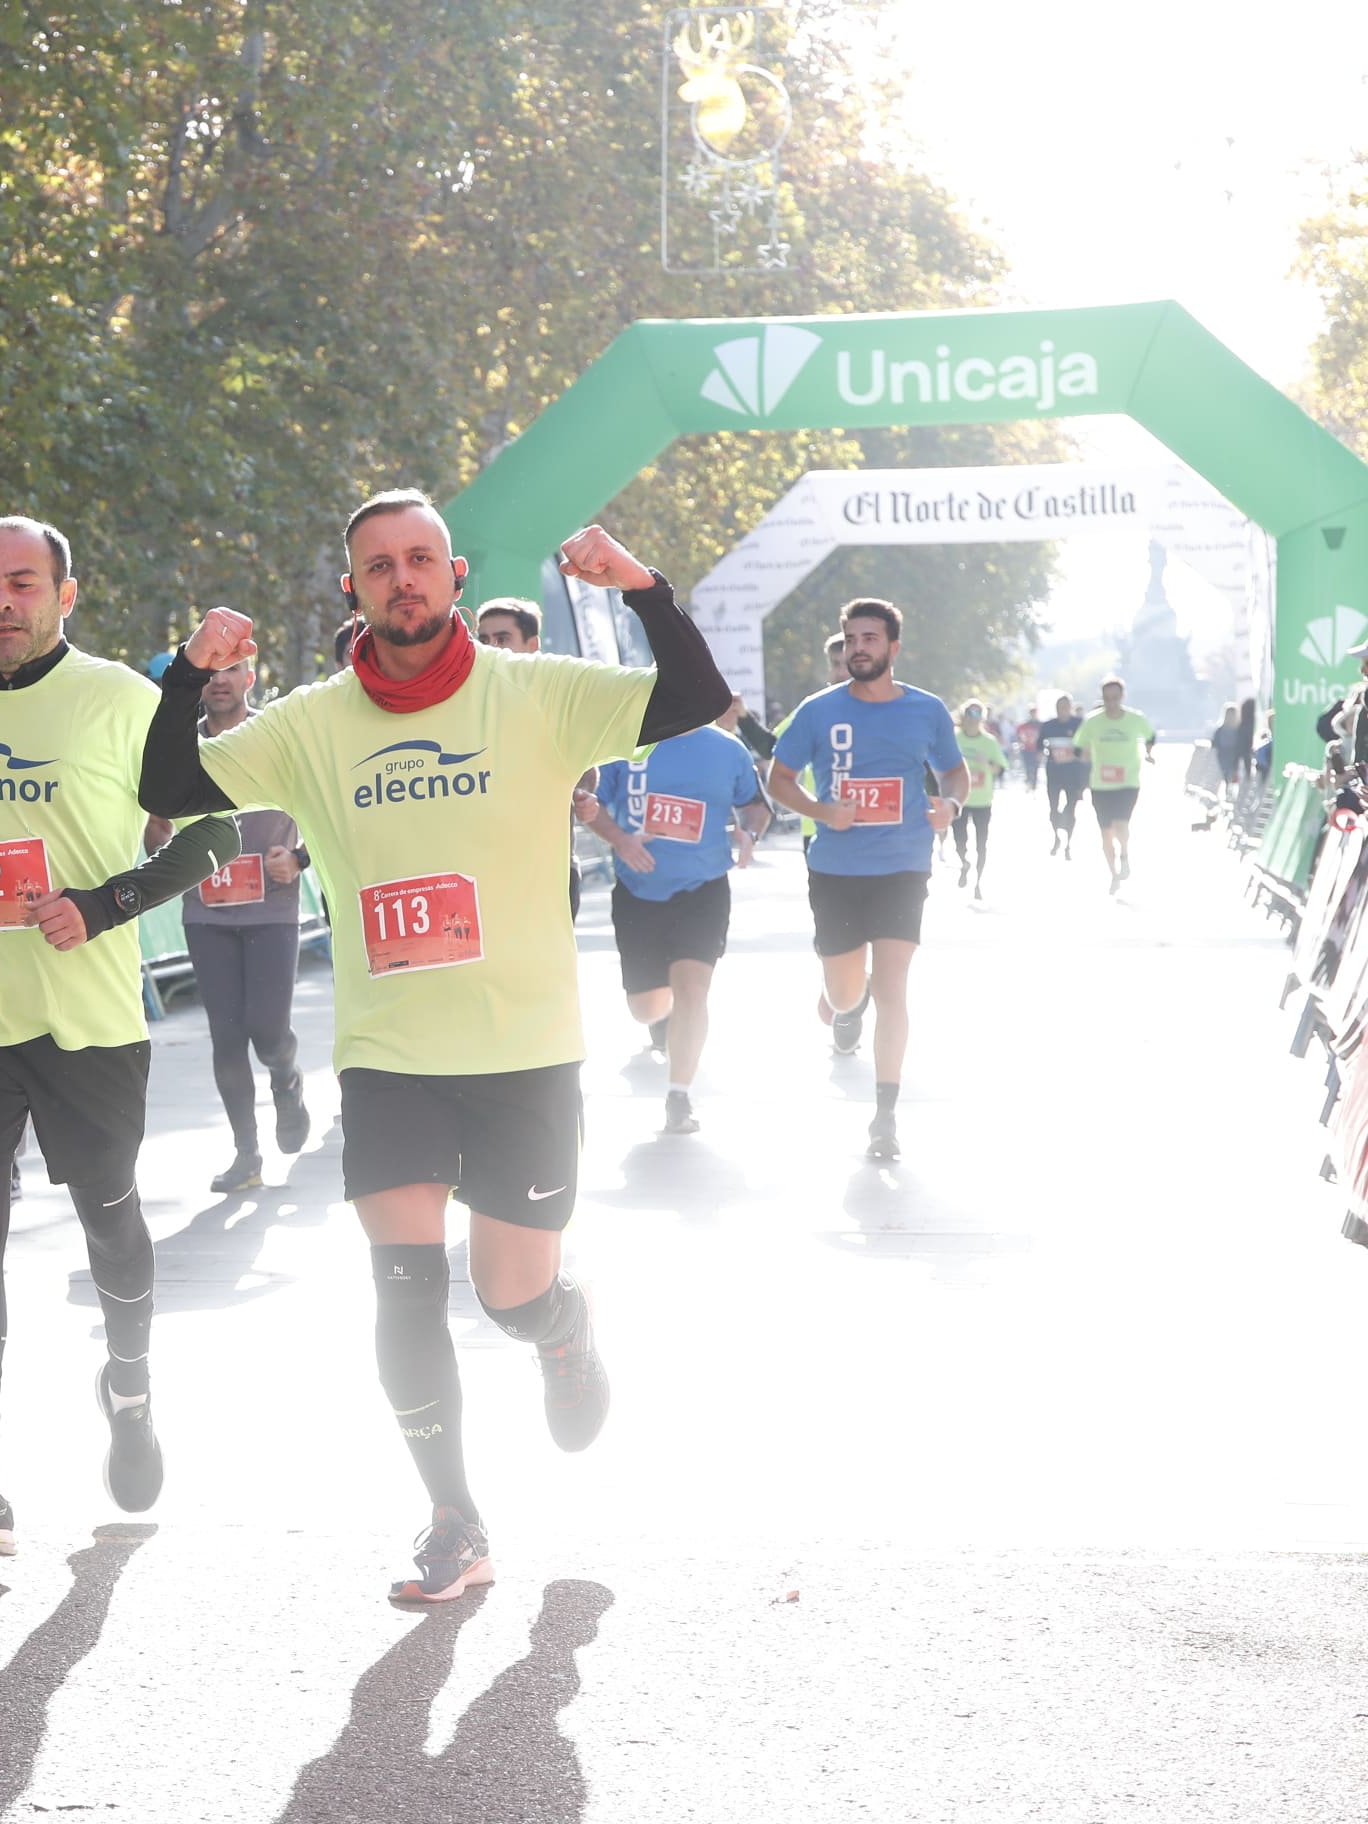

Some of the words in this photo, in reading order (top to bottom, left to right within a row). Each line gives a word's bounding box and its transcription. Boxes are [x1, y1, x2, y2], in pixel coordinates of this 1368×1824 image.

[837, 339, 1098, 410] Unicaja
[843, 491, 880, 525] El
[890, 491, 969, 524] Norte
[977, 492, 1006, 521] de
[1015, 484, 1136, 519] Castilla
[1283, 677, 1345, 705] Unic
[385, 759, 424, 774] grupo
[354, 770, 491, 808] elecnor
[651, 803, 683, 825] 213
[381, 891, 399, 899] Carrera
[407, 886, 434, 894] empresas
[435, 882, 458, 890] Adecco
[374, 895, 430, 940] 113
[401, 1423, 443, 1439] ARÇA
